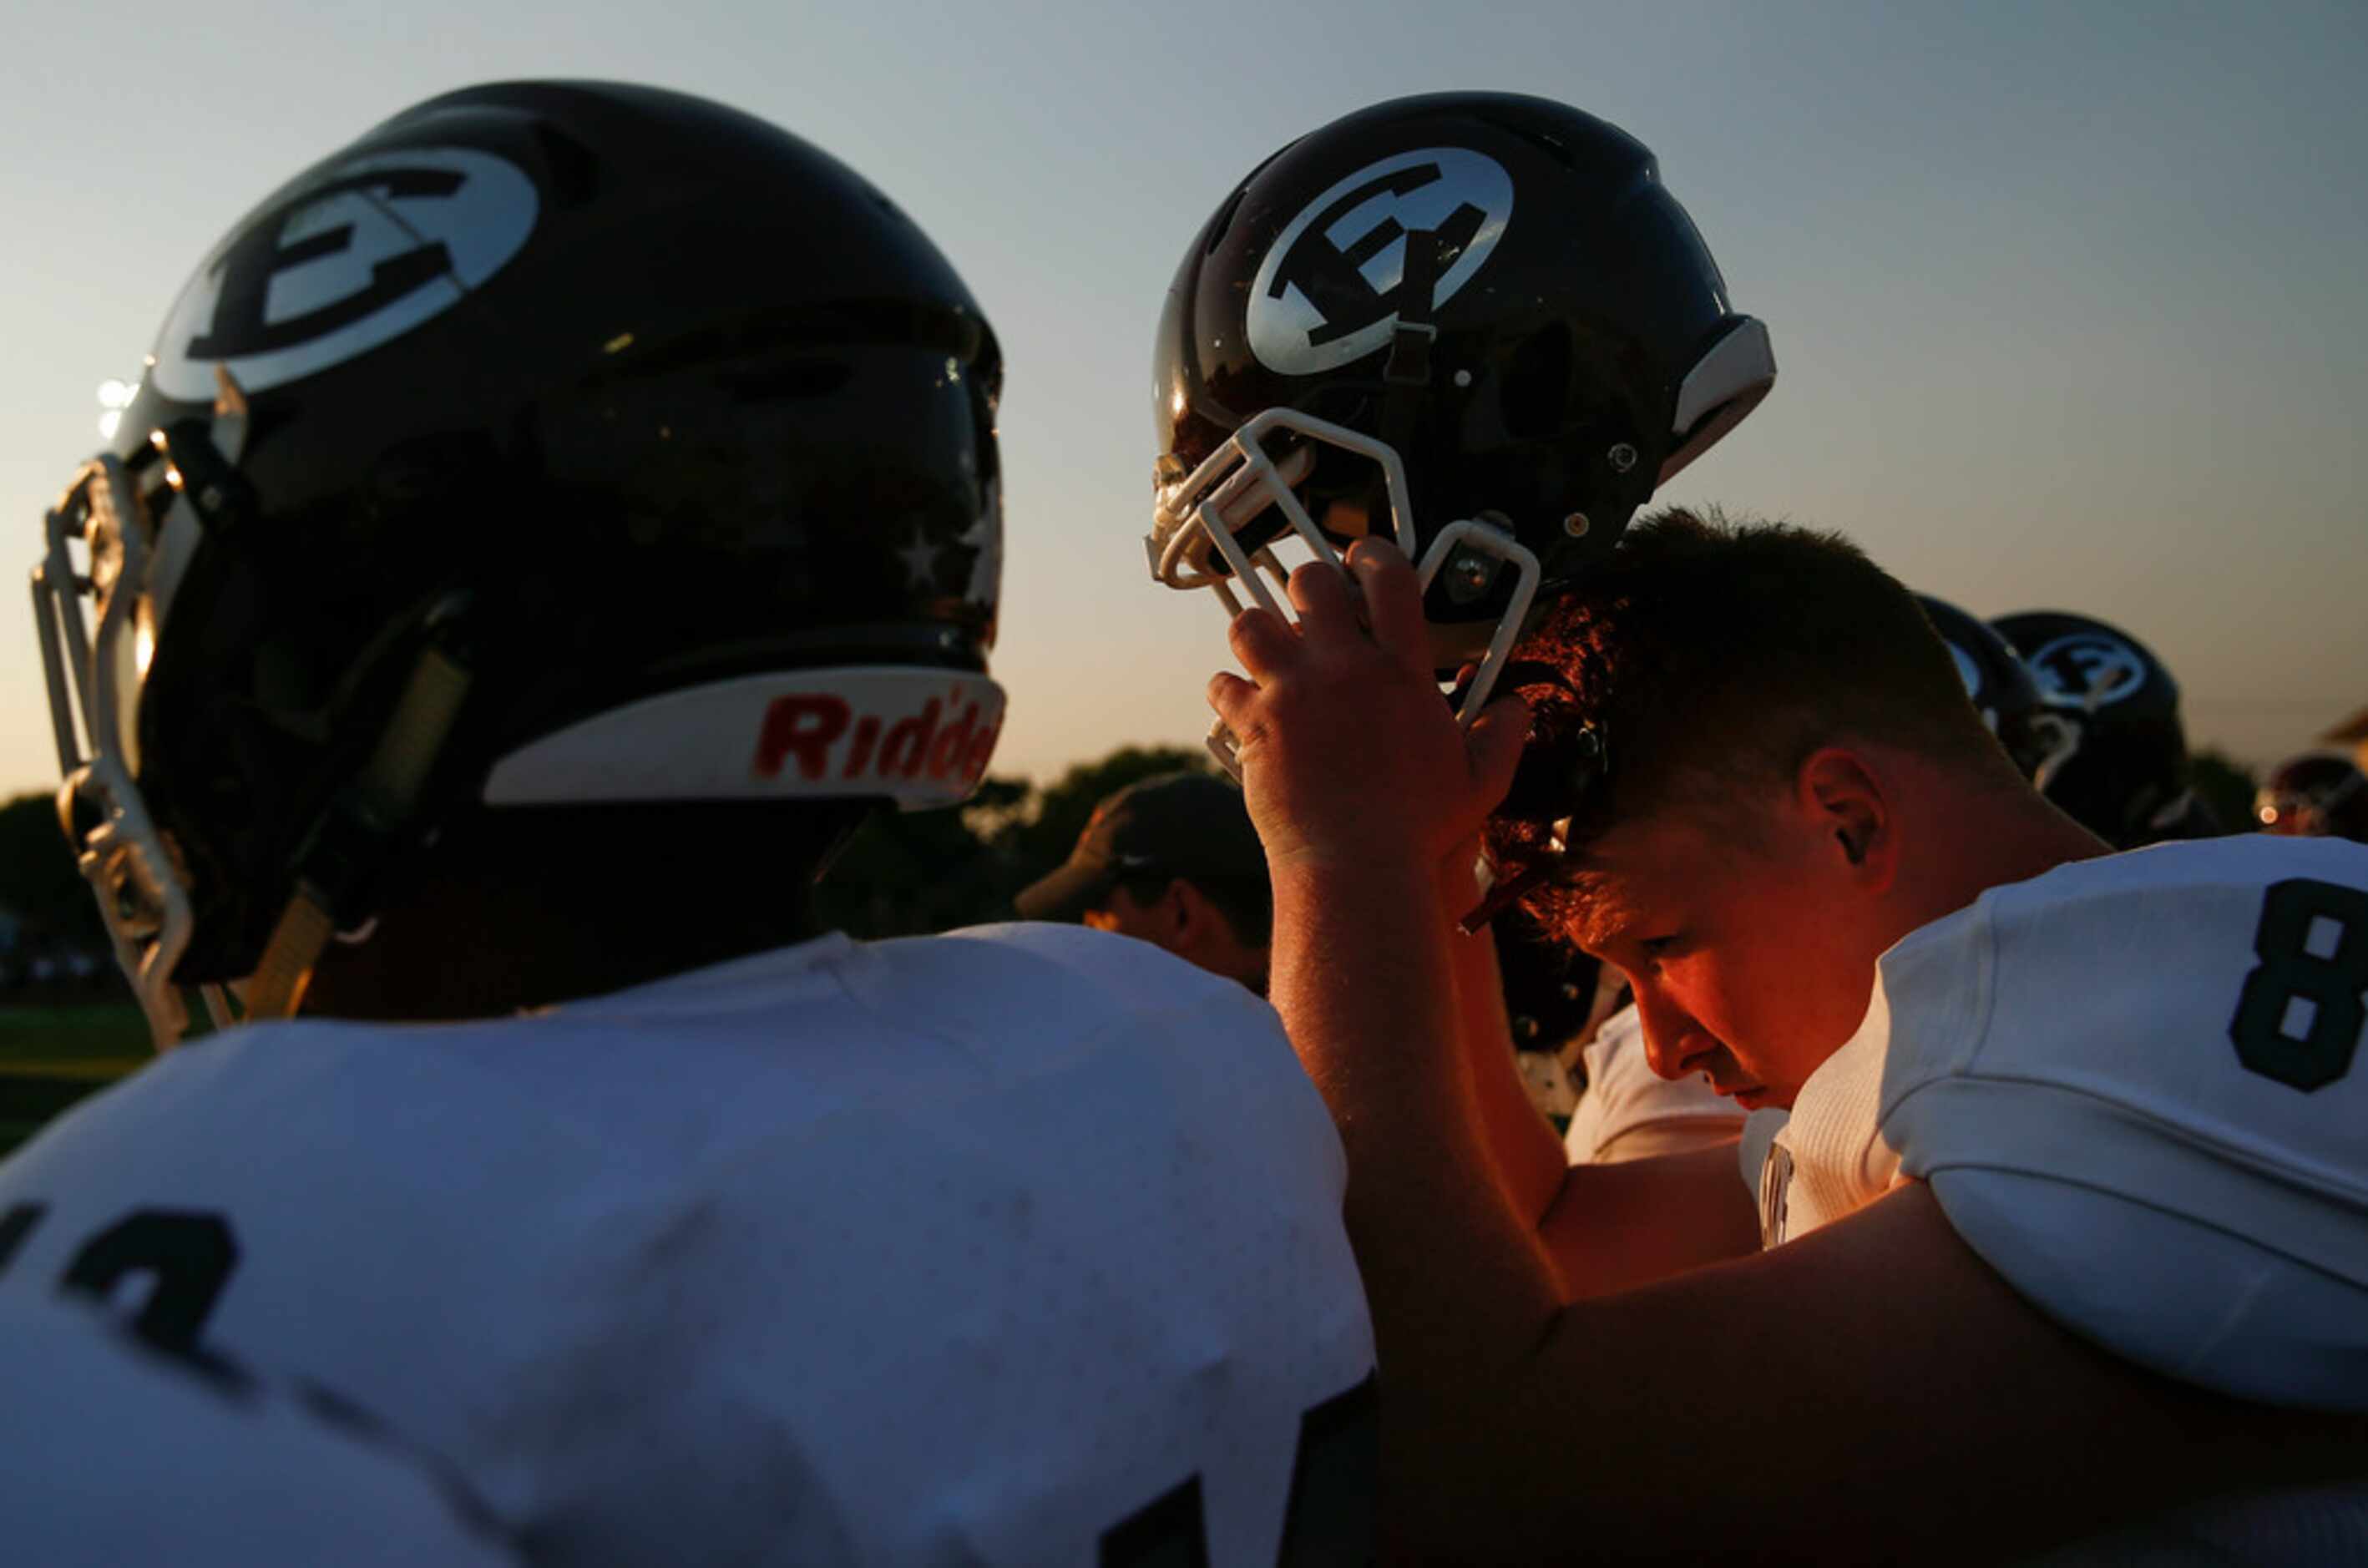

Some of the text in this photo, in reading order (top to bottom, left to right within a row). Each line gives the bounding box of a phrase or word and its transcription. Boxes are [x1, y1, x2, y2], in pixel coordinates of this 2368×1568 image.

[185, 169, 468, 360] E
[1267, 162, 1488, 347] E
[2228, 877, 2368, 1094] 8
